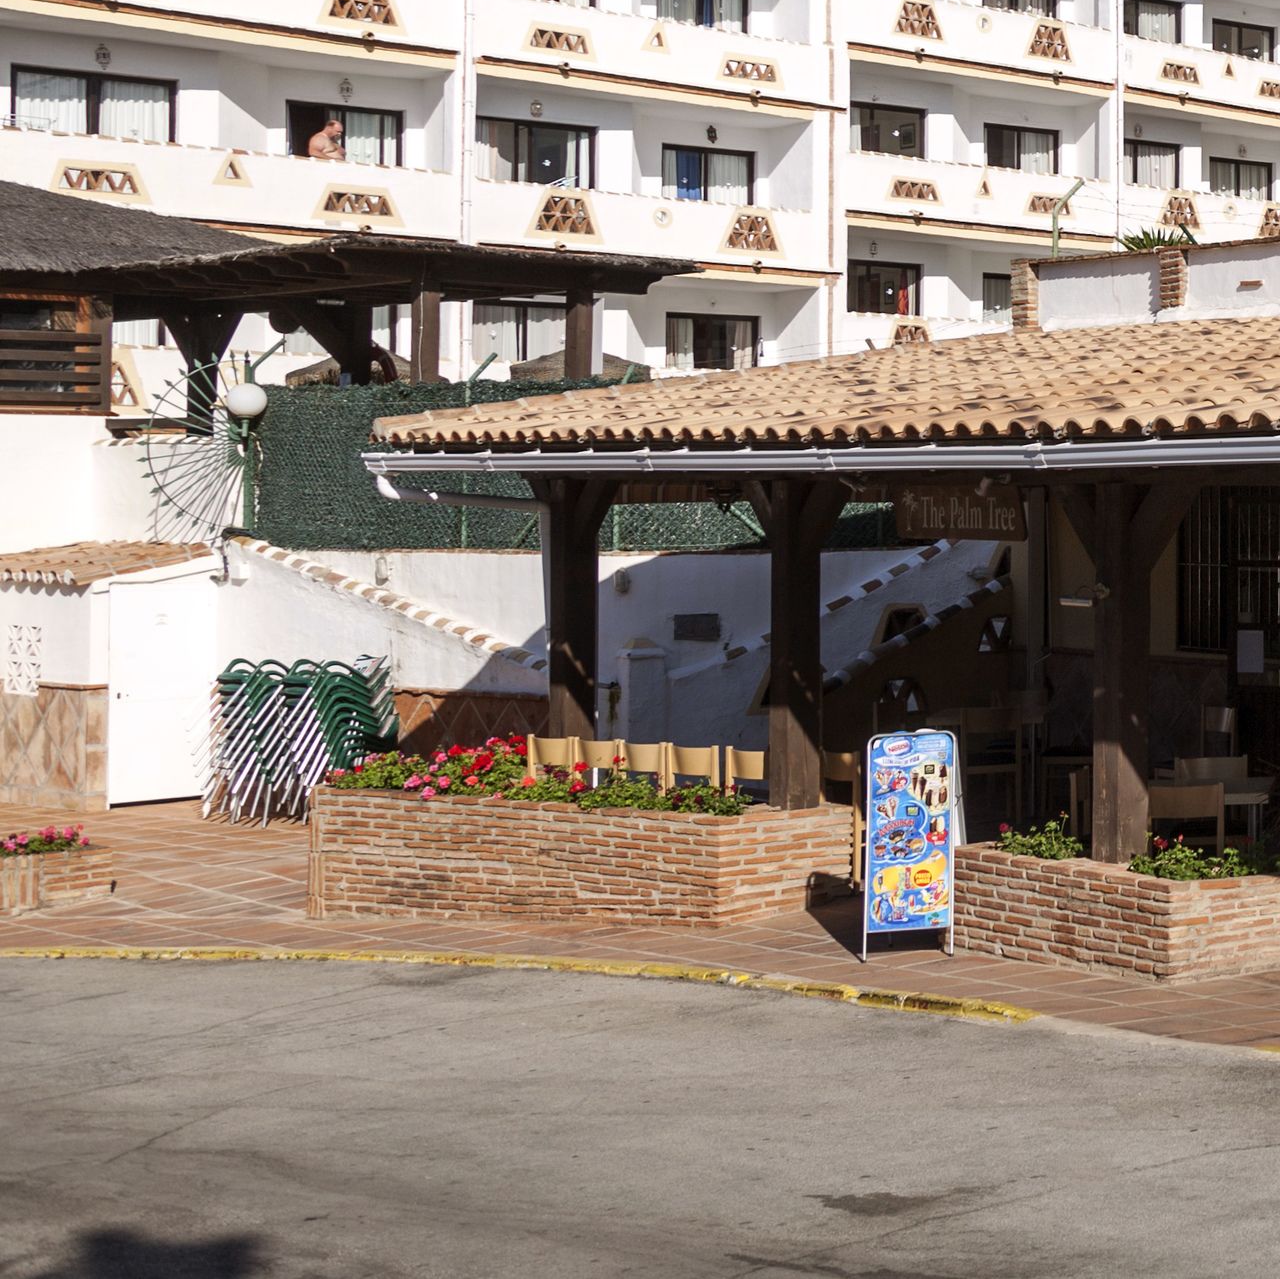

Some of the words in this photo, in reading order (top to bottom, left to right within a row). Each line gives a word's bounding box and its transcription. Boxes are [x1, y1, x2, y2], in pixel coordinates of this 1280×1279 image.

[920, 496, 945, 528] The
[950, 496, 982, 529] Palm
[987, 497, 1016, 531] Tree
